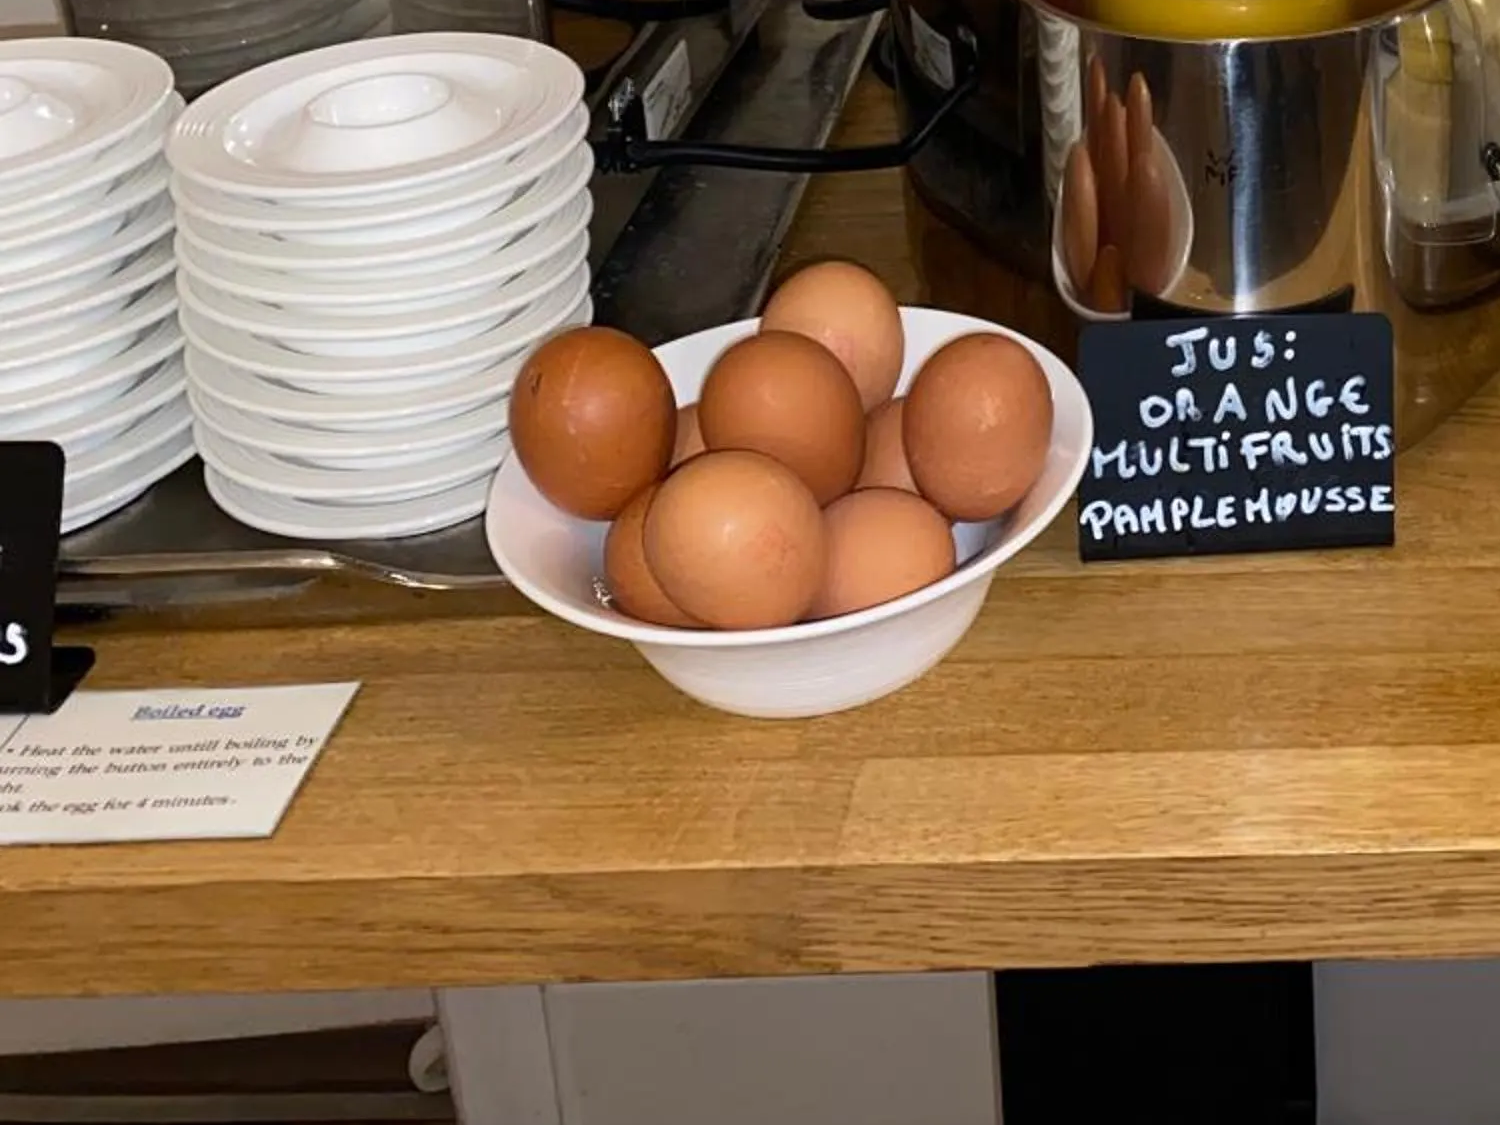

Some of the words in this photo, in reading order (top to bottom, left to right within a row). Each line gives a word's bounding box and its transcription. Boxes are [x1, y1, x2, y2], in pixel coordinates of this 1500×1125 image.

[1165, 326, 1296, 377] JUS:
[1139, 375, 1370, 427] ORANGE
[1080, 485, 1395, 540] PAMPLEMOUSSE
[131, 704, 206, 720] Boiled
[208, 705, 246, 719] egg
[71, 744, 102, 756] the
[109, 744, 163, 756] water
[224, 735, 290, 751] boiling
[295, 734, 318, 750] by
[68, 762, 99, 774] the
[103, 761, 167, 775] button
[173, 754, 245, 771] entirely
[252, 755, 273, 767] to
[278, 752, 309, 766] the
[28, 800, 61, 813] the
[62, 801, 99, 815] egg
[103, 797, 132, 811] for
